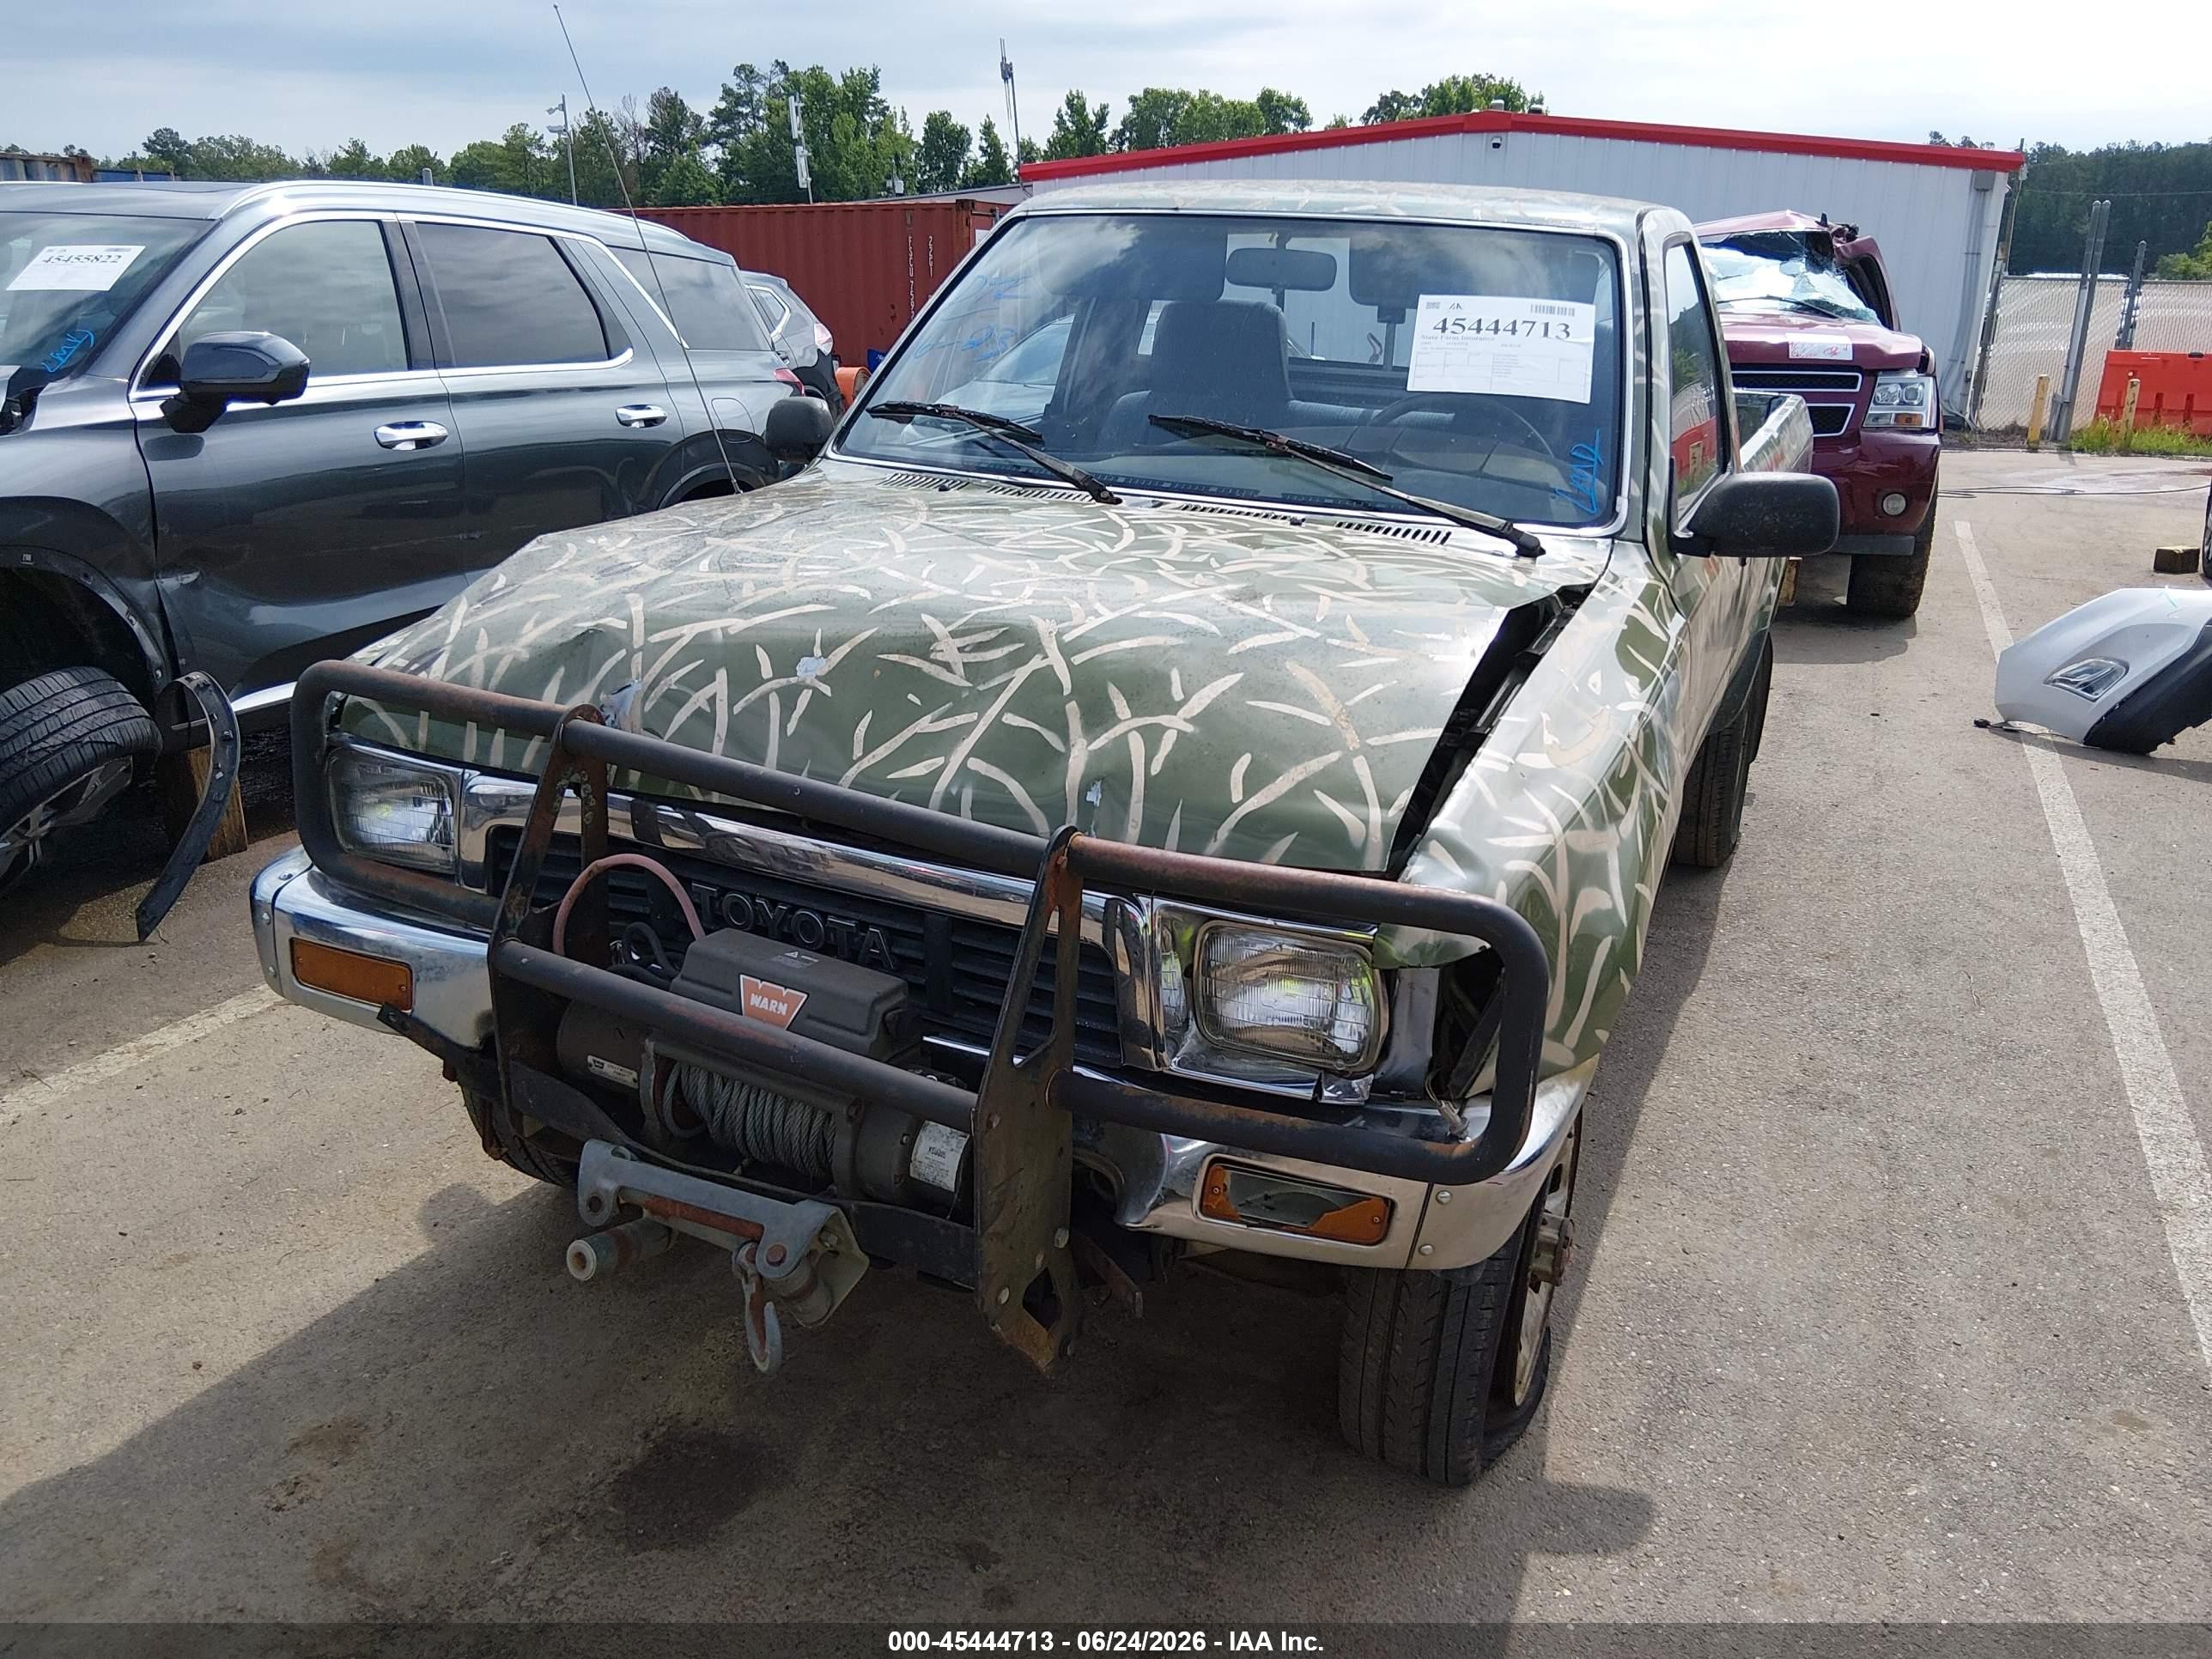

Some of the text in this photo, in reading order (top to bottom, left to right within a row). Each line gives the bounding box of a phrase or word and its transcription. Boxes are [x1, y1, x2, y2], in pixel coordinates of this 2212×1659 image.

[42, 254, 122, 264] 45455822
[1432, 317, 1571, 340] 45444713
[691, 880, 895, 969] TOYOTA
[750, 993, 787, 1016] WARN
